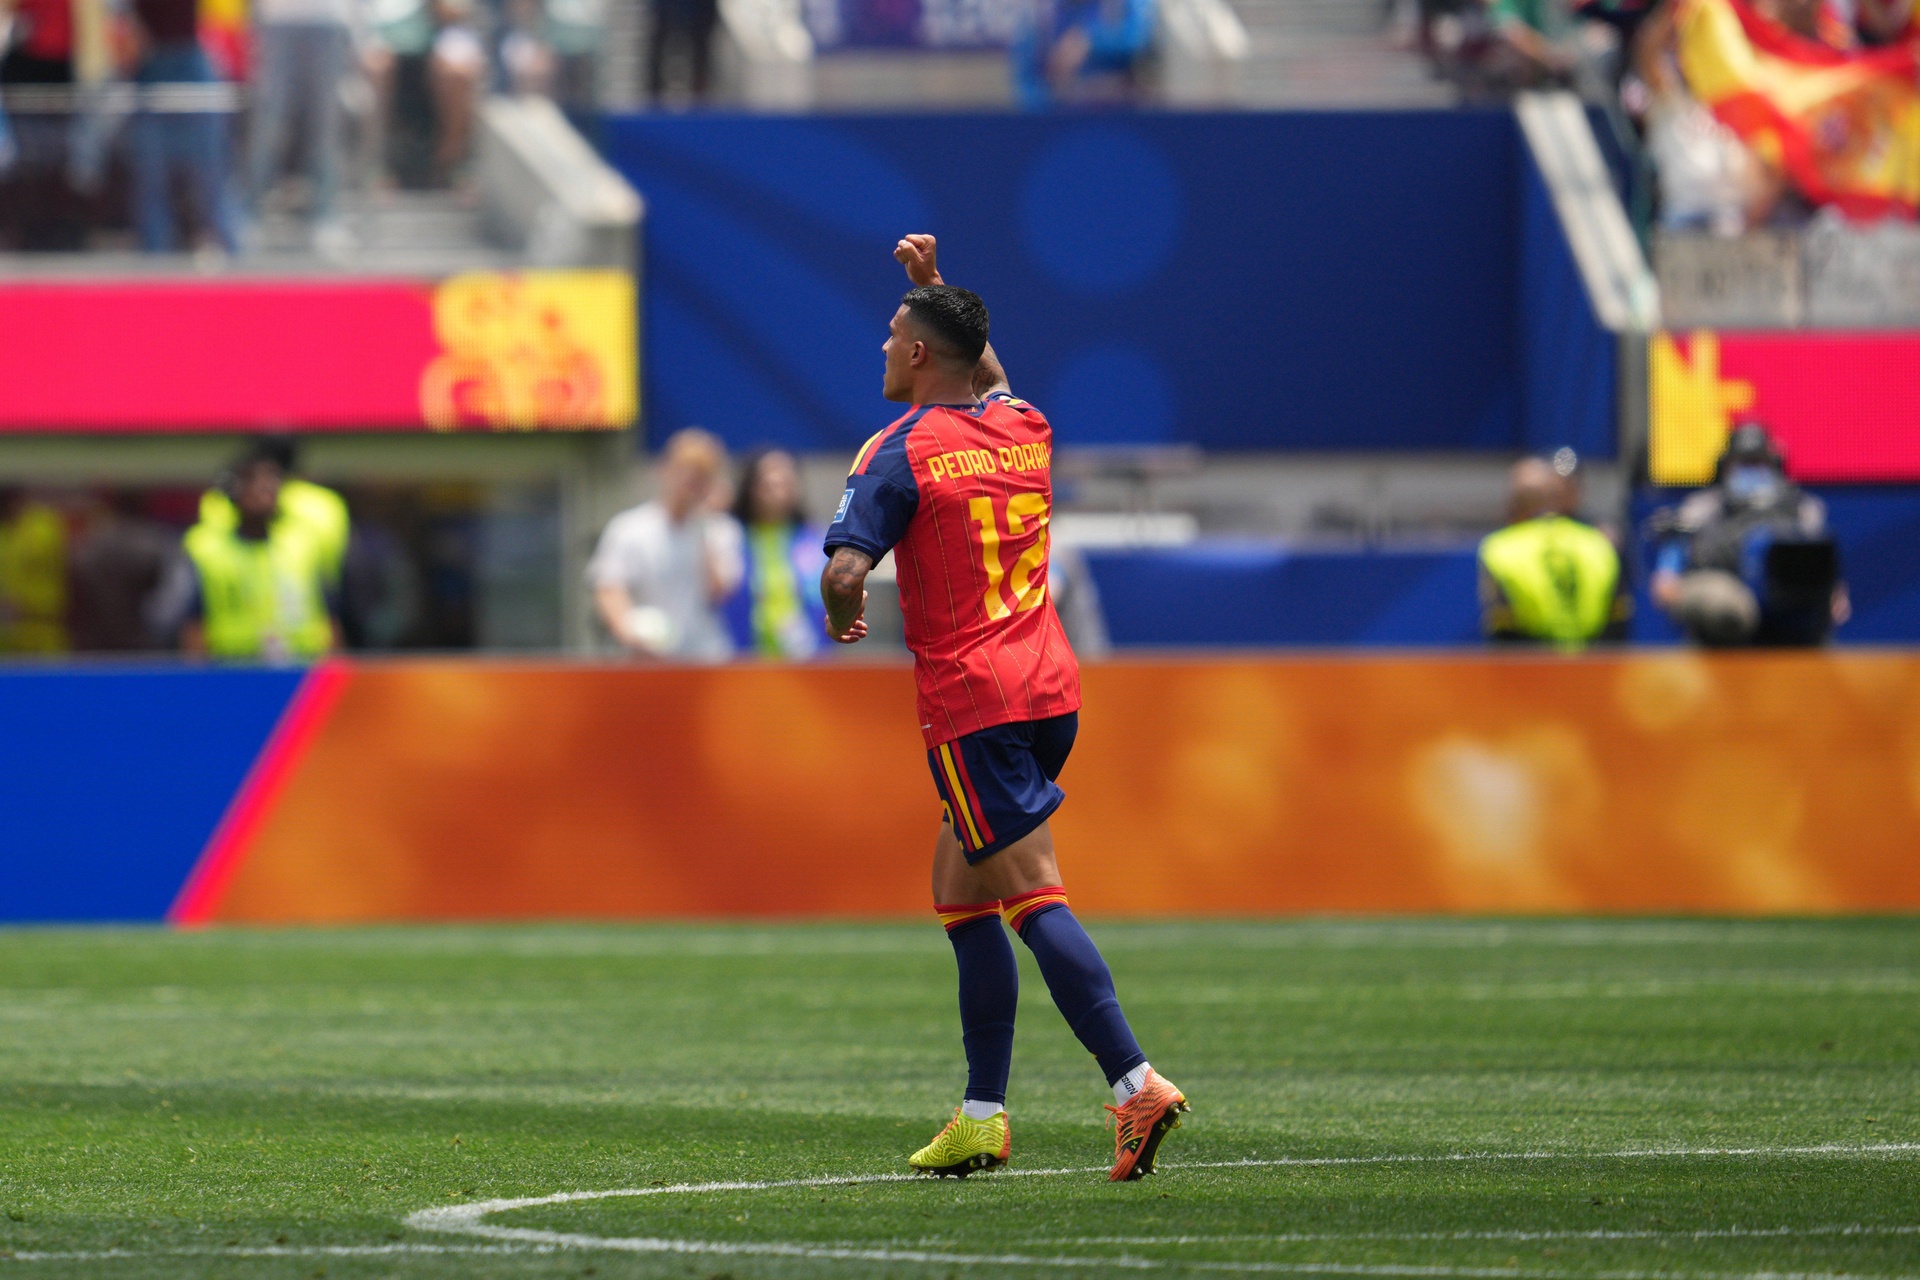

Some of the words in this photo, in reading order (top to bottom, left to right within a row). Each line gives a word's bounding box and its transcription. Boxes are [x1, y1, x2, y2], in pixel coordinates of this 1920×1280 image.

[927, 449, 997, 482] PEDRO
[997, 441, 1050, 473] PORRO
[968, 492, 1049, 621] 12
